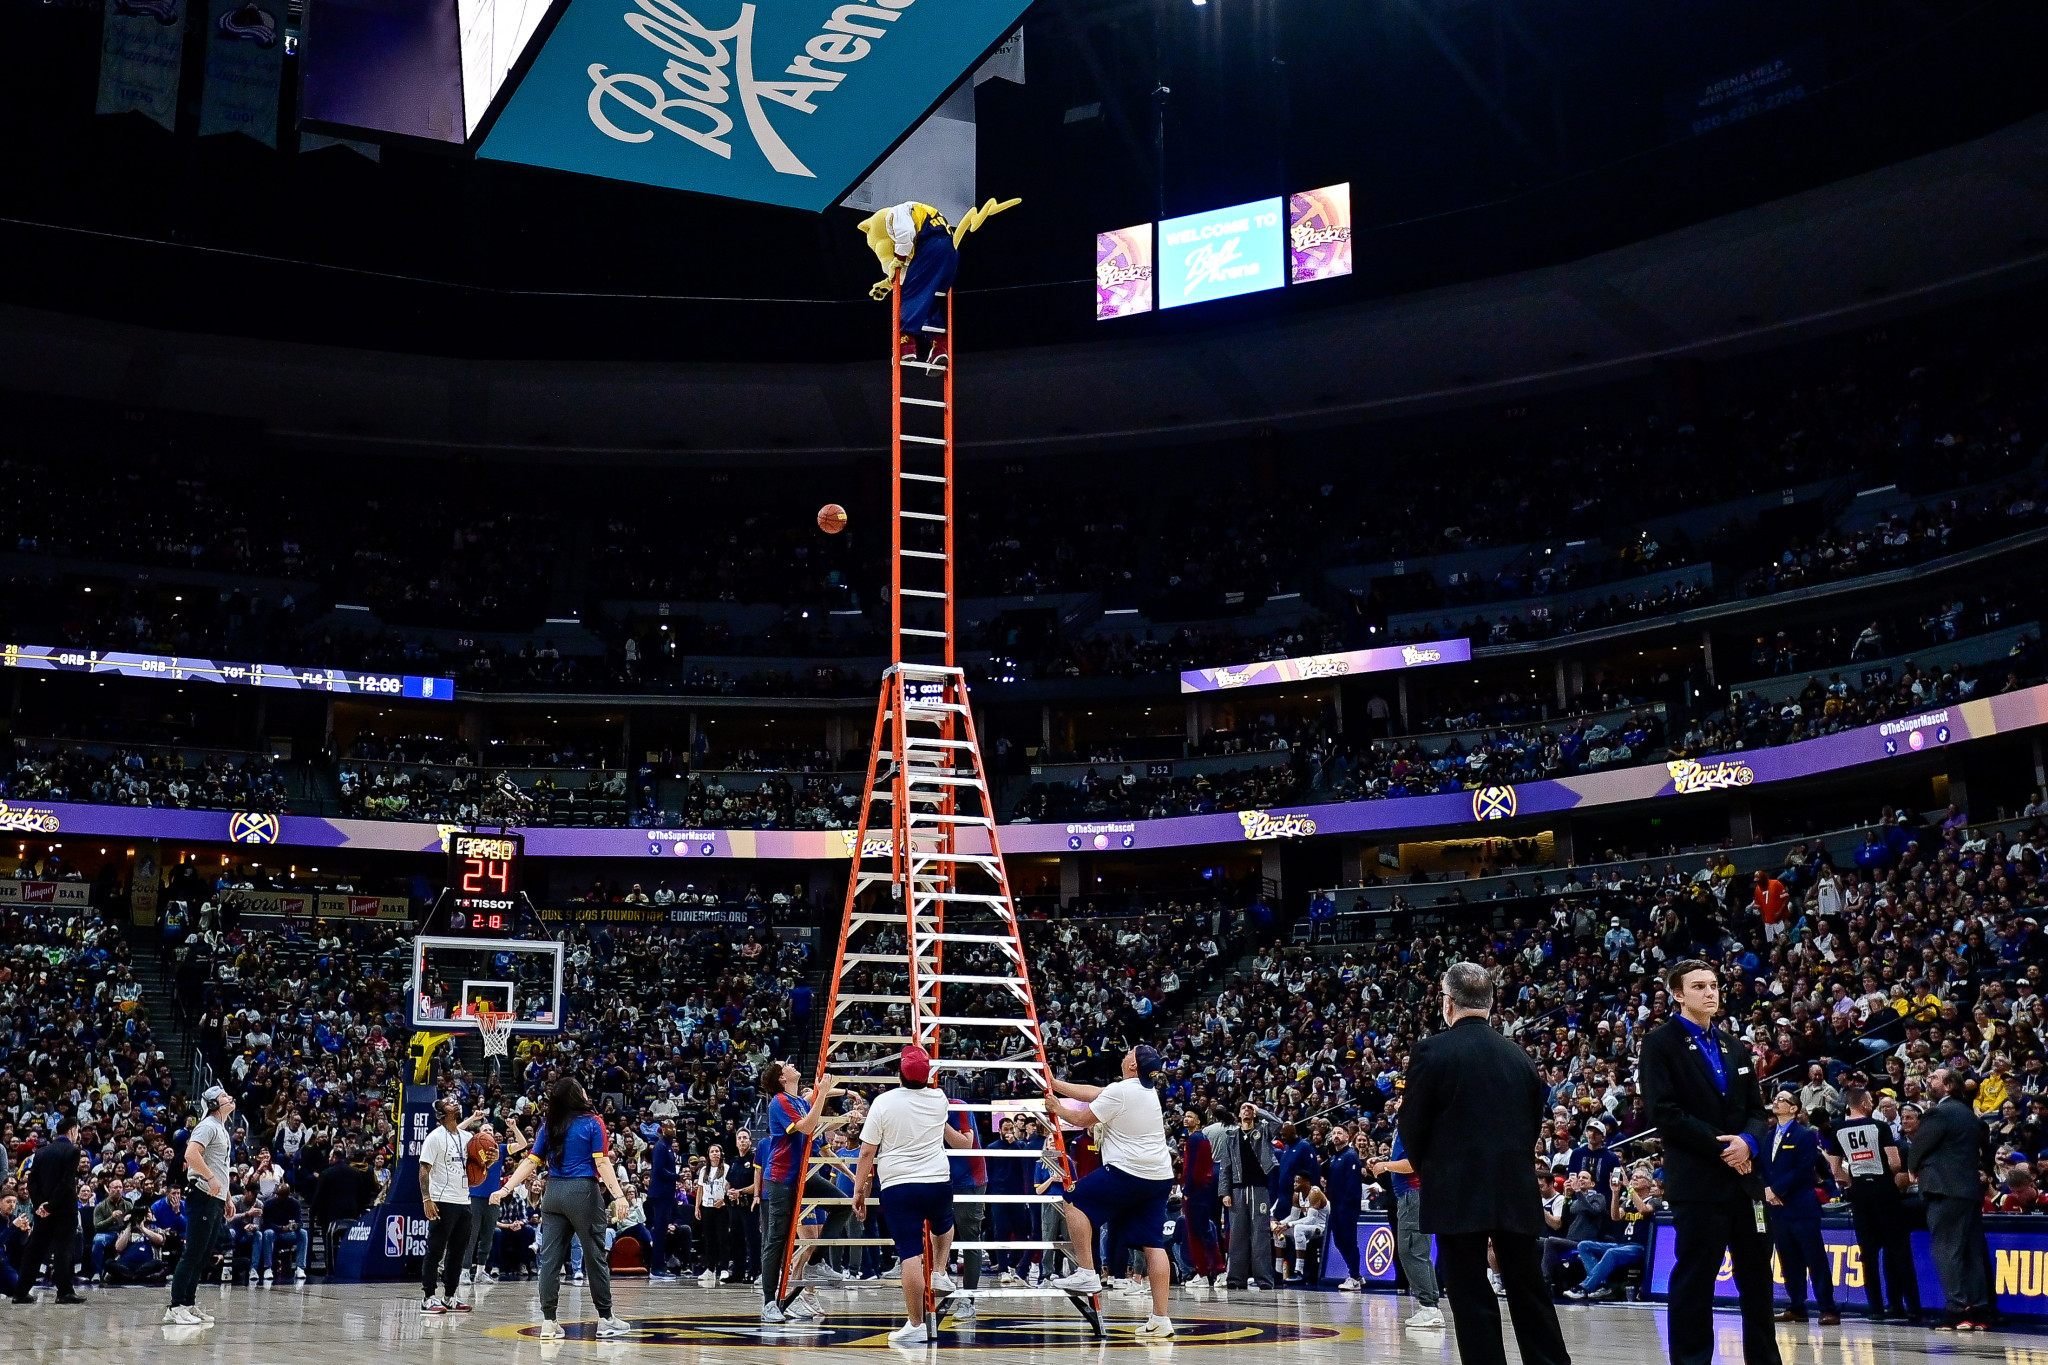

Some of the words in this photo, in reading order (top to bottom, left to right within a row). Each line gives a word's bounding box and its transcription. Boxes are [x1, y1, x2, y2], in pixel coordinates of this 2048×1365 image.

[1165, 218, 1250, 247] WELCOME
[1253, 212, 1279, 230] TO
[60, 654, 85, 665] ORB
[171, 658, 178, 667] 7
[142, 660, 166, 672] DRB
[251, 664, 262, 674] 12
[171, 669, 183, 679] 12
[223, 666, 246, 679] TOT
[302, 673, 323, 684] FLS
[327, 670, 333, 679] 0
[326, 681, 332, 690] 0
[358, 676, 400, 693] 12:00
[1879, 710, 1948, 736] @TheSuperMascot
[1152, 767, 1169, 775] 252
[1685, 761, 1742, 792] Rocky
[1067, 823, 1135, 834] @TheSuperMascot
[1254, 812, 1306, 840] Rocky
[647, 831, 716, 841] @TheSuperMascot
[463, 859, 508, 893] 24
[25, 884, 54, 900] Banquet
[60, 890, 84, 898] BAR
[321, 902, 345, 910] THE
[351, 899, 378, 914] Banquet
[382, 904, 404, 912] BAR
[472, 899, 514, 910] TISSOT
[473, 914, 502, 928] 2:18
[671, 910, 748, 922] EDDIESKIDS.ORG
[414, 1113, 430, 1127] GET
[1848, 1130, 1868, 1149] 64
